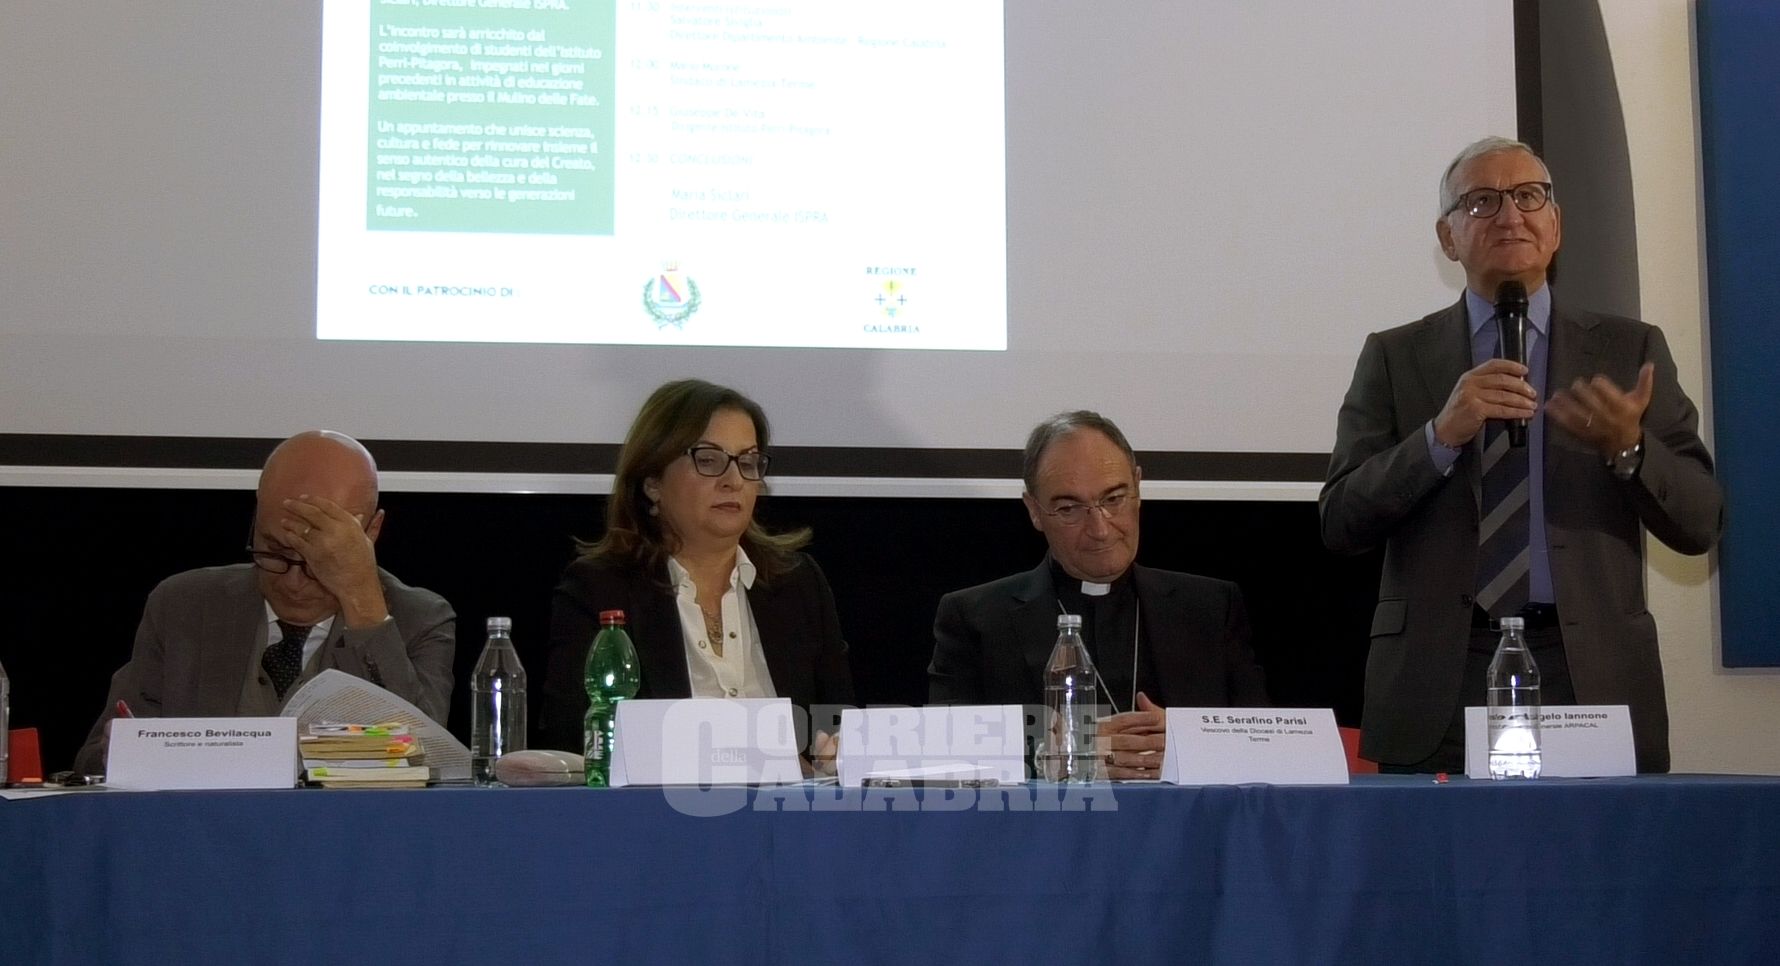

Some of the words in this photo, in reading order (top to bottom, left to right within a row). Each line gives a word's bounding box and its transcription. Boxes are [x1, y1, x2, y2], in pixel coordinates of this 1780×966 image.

[441, 26, 466, 39] sarà
[379, 41, 468, 56] coinvolgimento
[470, 43, 482, 55] di
[484, 45, 532, 57] studenti
[378, 73, 442, 87] precedenti
[445, 74, 456, 86] in
[458, 74, 501, 87] attività
[503, 76, 515, 88] di
[517, 76, 583, 90] educazione
[378, 88, 445, 101] ambientale
[447, 92, 484, 104] presso
[378, 120, 394, 132] Un
[397, 122, 483, 136] appuntamento
[484, 122, 507, 135] che
[508, 124, 546, 137] unisce
[377, 136, 419, 149] cultura
[421, 140, 430, 150] e
[433, 137, 460, 150] fede
[462, 141, 483, 153] per
[485, 139, 541, 152] rinnovare
[377, 154, 410, 165] senso
[412, 154, 468, 166] autentico
[470, 155, 500, 167] della
[502, 157, 528, 168] cura
[531, 155, 549, 168] del
[376, 168, 396, 181] nel
[398, 171, 432, 184] segno
[435, 169, 464, 182] della
[466, 170, 515, 183] bellezza
[517, 174, 526, 184] e
[528, 171, 557, 184] della
[376, 184, 458, 199] responsabilità
[460, 188, 492, 199] verso
[494, 186, 506, 199] le
[508, 189, 575, 202] generazioni
[376, 204, 418, 217] future.
[866, 266, 917, 276] REGIONE
[368, 284, 398, 295] CON
[402, 285, 412, 295] IL
[418, 286, 497, 297] PATROCINIO
[863, 324, 920, 333] CALABRIA
[1201, 715, 1224, 724] S.E.
[1226, 715, 1273, 725] Serafino
[1275, 716, 1307, 725] Parisi
[1564, 712, 1608, 720] Iannone
[137, 729, 202, 738] Francesco
[205, 729, 272, 739] Bevilacqua
[1248, 735, 1270, 743] Terme
[164, 740, 196, 748] Scrittore
